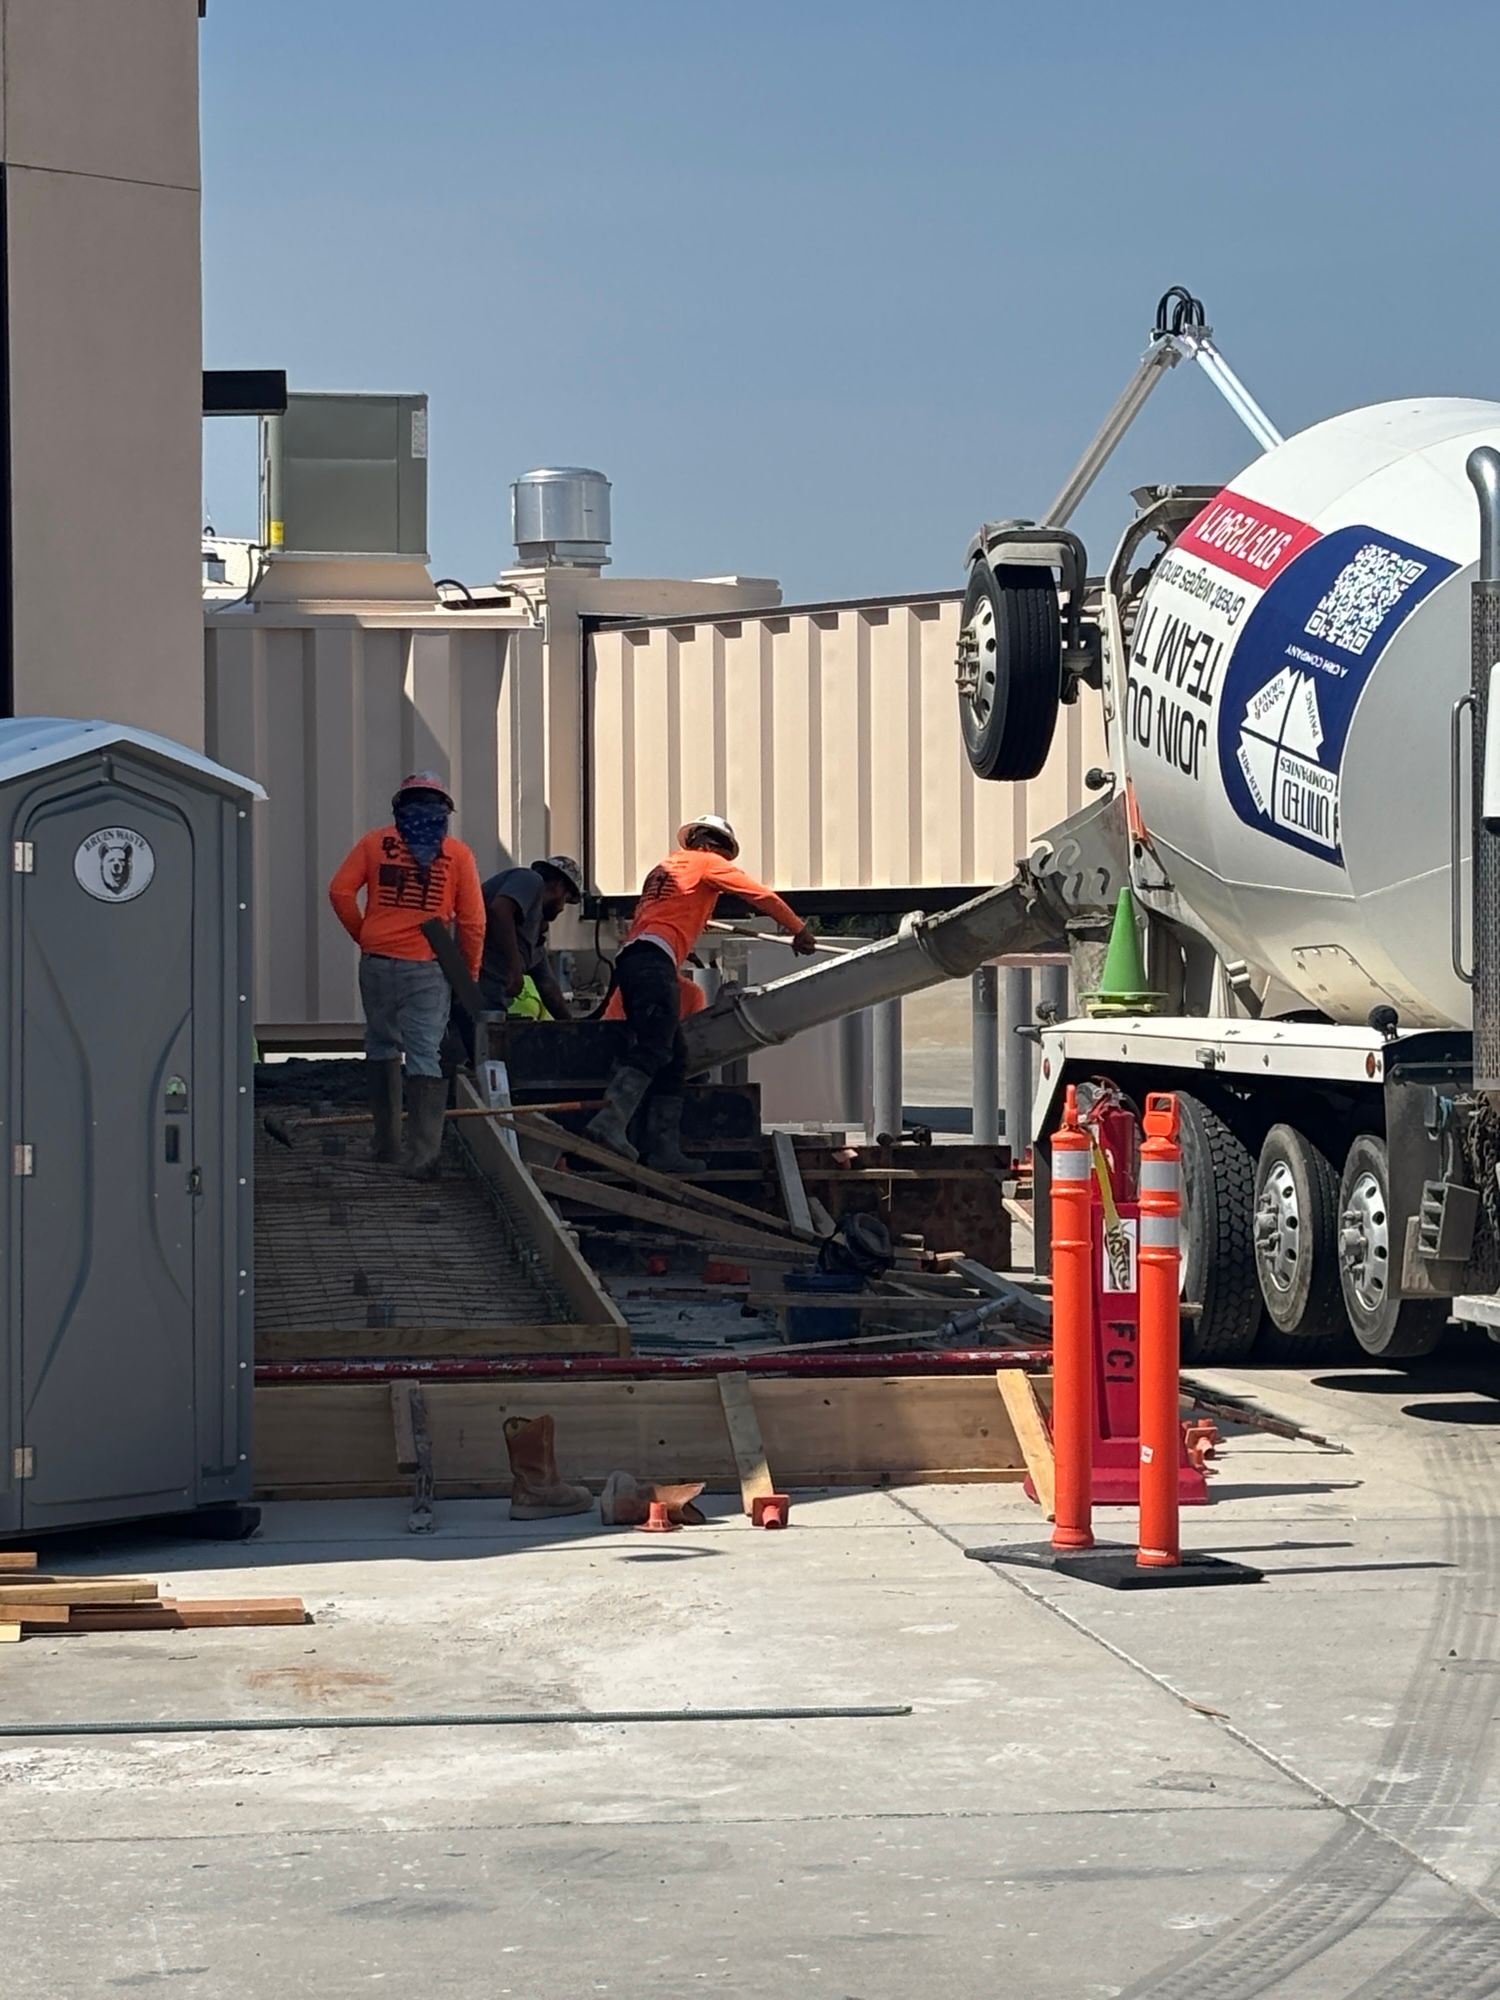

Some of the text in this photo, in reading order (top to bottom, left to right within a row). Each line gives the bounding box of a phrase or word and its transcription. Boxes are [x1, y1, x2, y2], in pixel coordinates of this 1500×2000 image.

[1194, 503, 1293, 571] 970-712-9471
[1178, 566, 1216, 604] wages
[1209, 585, 1246, 627] Great
[1131, 604, 1224, 707] TEAM T
[1284, 643, 1324, 669] COMPANY
[1340, 666, 1349, 678] A
[1252, 678, 1284, 711] GRAVEL
[1262, 689, 1286, 713] SAND
[1305, 690, 1320, 739] PAVING
[1156, 695, 1207, 781] JOIN
[1280, 756, 1335, 793] COMPANIES
[1282, 779, 1330, 840] UNITED
